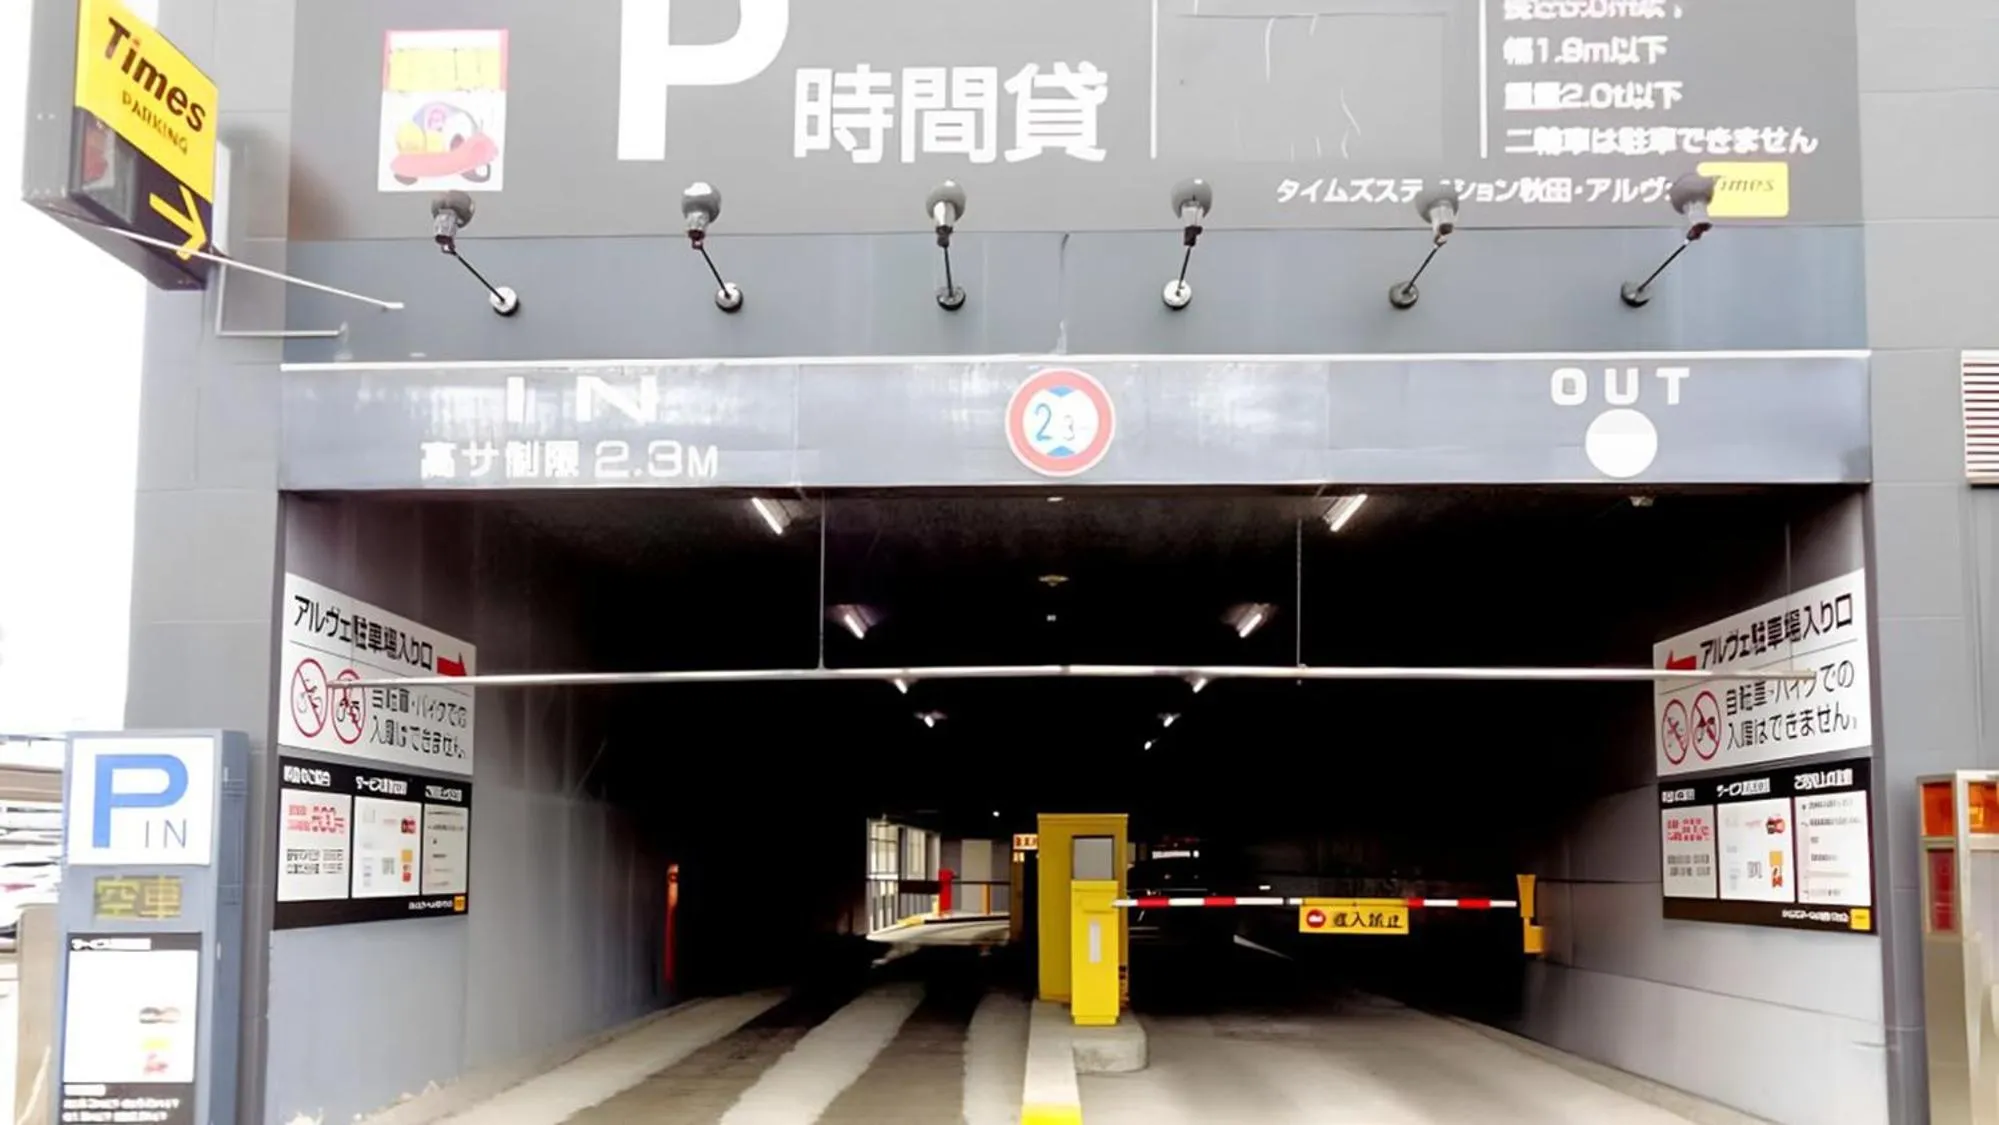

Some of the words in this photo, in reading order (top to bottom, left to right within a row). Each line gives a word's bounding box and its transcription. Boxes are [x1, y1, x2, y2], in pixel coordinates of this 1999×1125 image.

[105, 16, 206, 132] Times
[617, 0, 790, 160] P
[794, 60, 1108, 163] 時間貸
[1277, 177, 1672, 203] タイムズステション秋田・アルヴ
[506, 375, 658, 423] IN
[1551, 367, 1690, 406] OUT
[594, 440, 719, 479] 2.3M
[1700, 592, 1853, 670] アルヴェ駐車場入り口
[92, 754, 189, 849] P
[145, 818, 187, 849] IN
